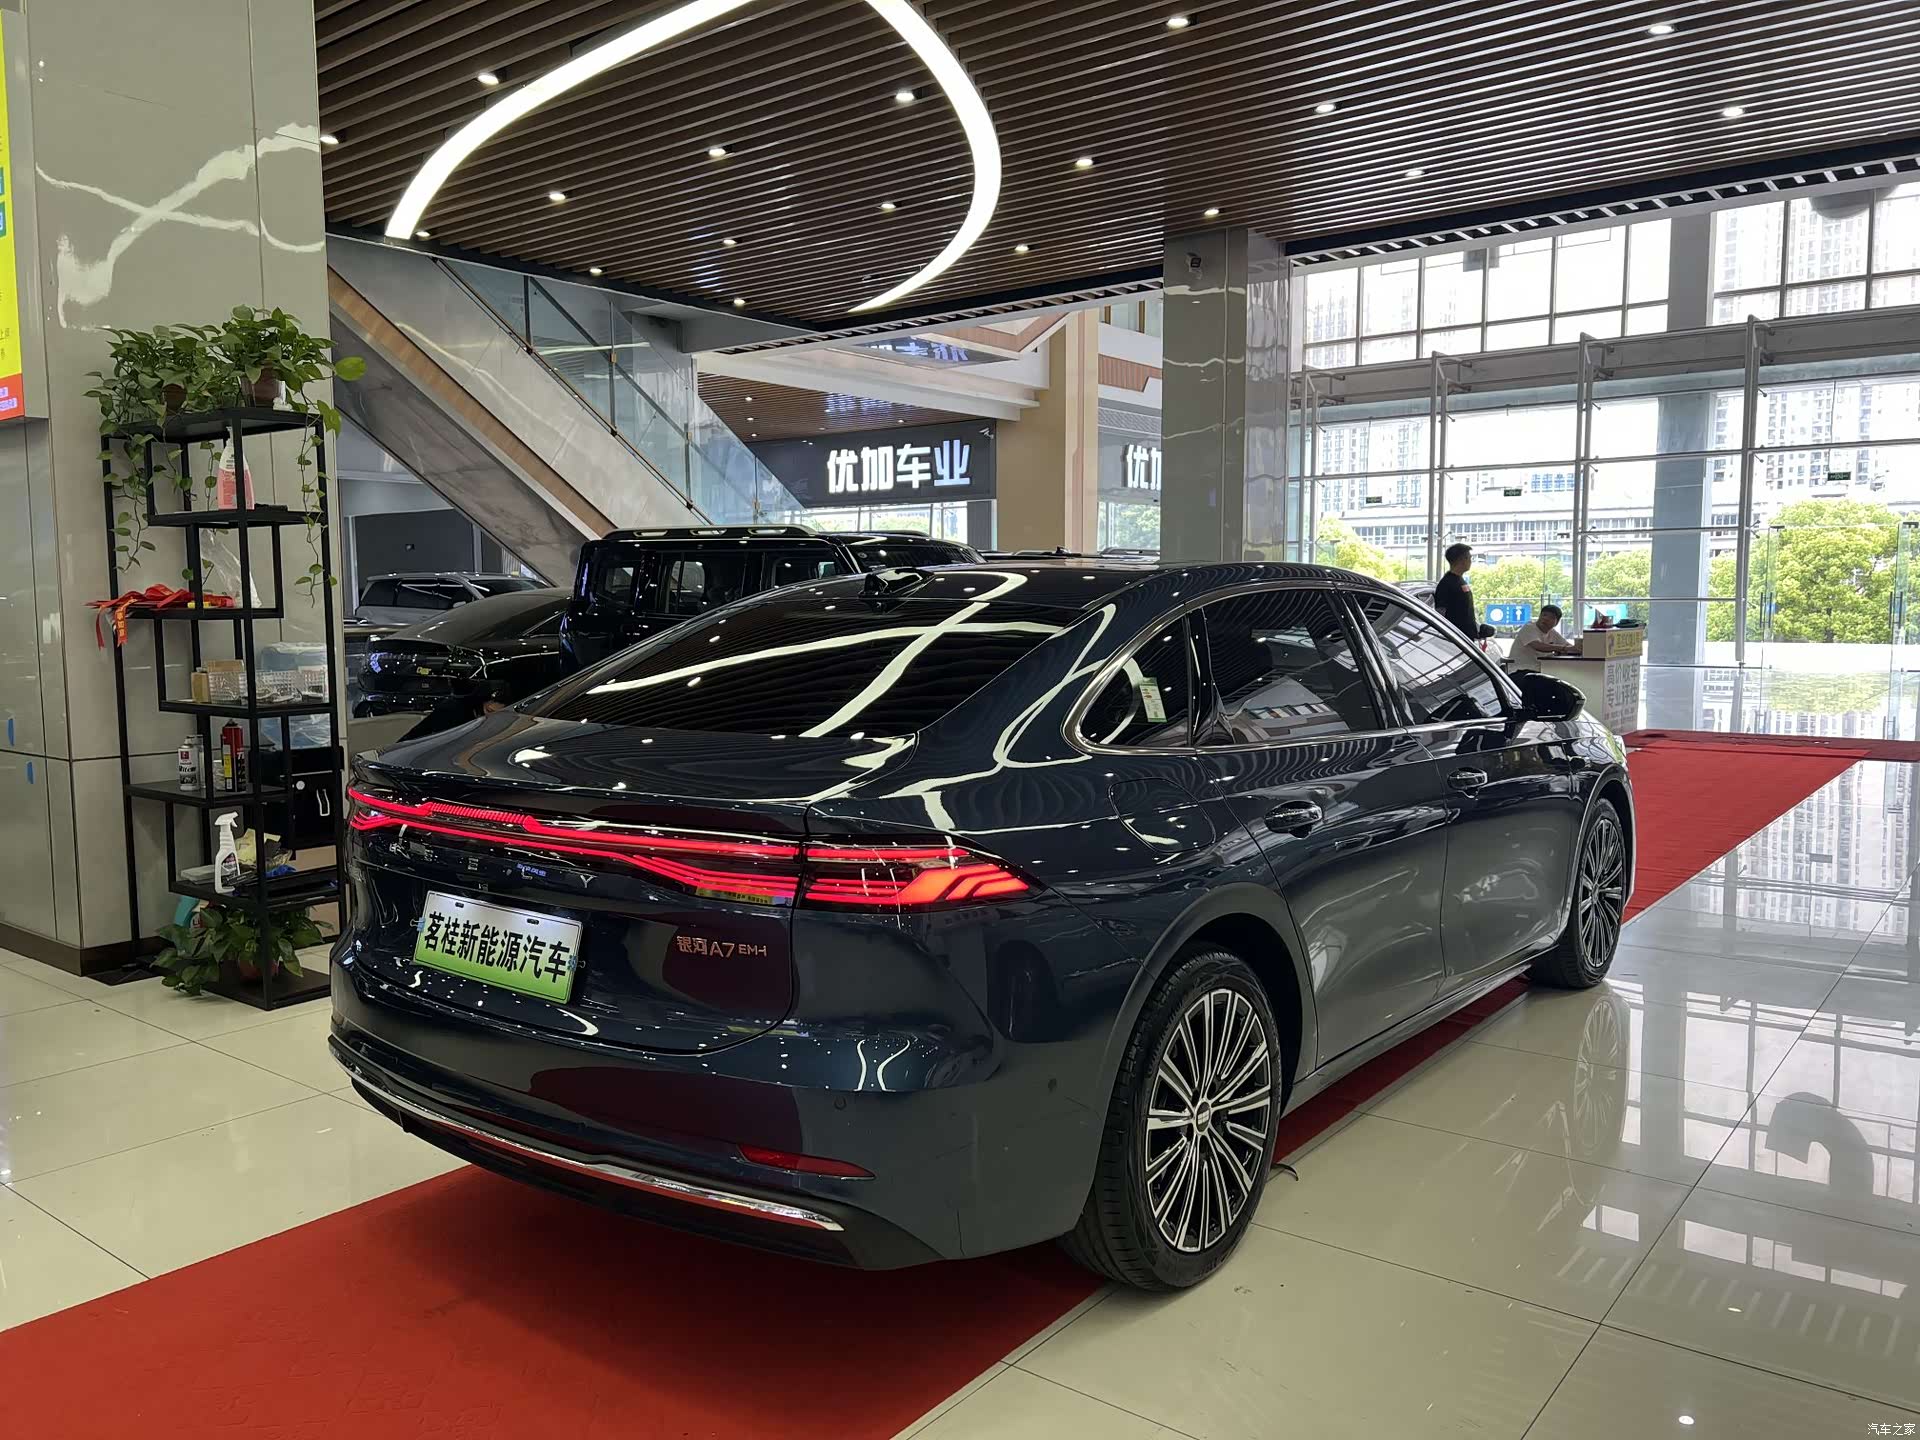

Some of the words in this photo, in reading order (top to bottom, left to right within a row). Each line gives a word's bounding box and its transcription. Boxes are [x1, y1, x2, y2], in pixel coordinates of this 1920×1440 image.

[827, 439, 971, 494] 优加车业
[1607, 660, 1638, 686] 高价收车
[1607, 684, 1638, 707] 专业评估
[424, 911, 571, 984] 茗桂新能源汽车
